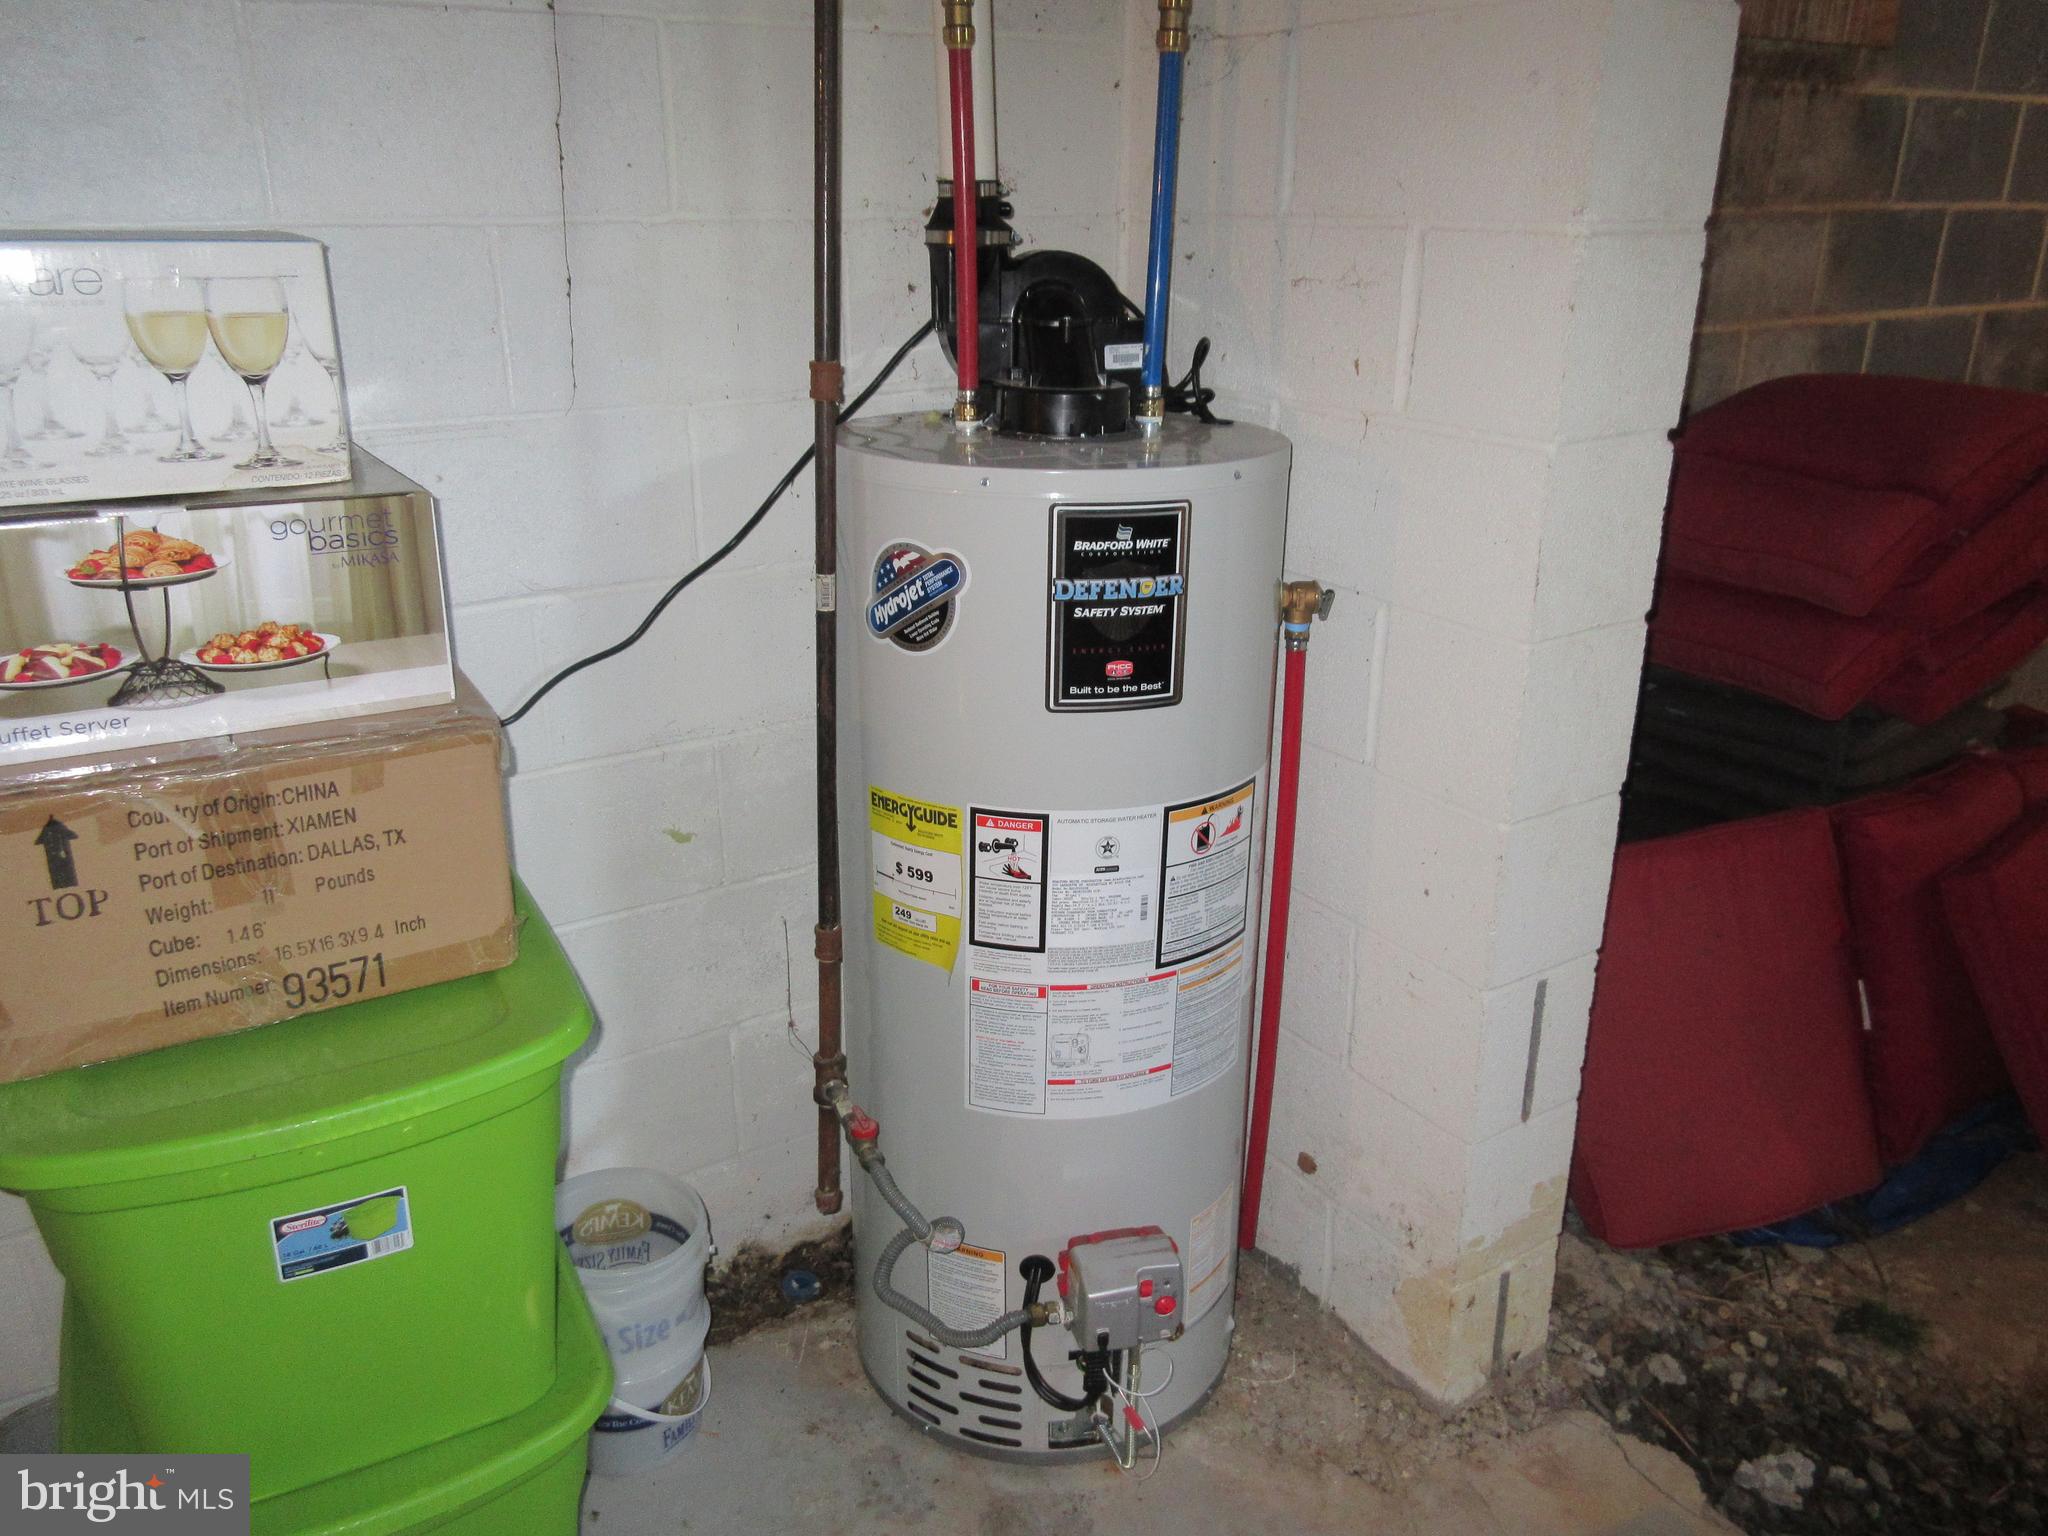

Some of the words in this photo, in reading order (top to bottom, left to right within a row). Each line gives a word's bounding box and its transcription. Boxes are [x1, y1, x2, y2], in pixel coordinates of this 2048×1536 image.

[270, 508, 393, 541] gourmet
[308, 529, 399, 552] basics
[1074, 540, 1133, 551] BRADFORD
[1136, 538, 1169, 549] WHITE
[341, 551, 399, 568] MIKASA
[1081, 549, 1162, 557] CORPORATION
[1054, 575, 1184, 601] DEFENDER
[873, 577, 925, 625] Hydrojet
[1074, 607, 1118, 618] SAFETY
[1120, 604, 1164, 616] SYSTEM
[1069, 686, 1092, 694] Built
[1094, 686, 1105, 694] to
[1107, 685, 1120, 693] be
[1122, 684, 1138, 692] the
[1141, 682, 1163, 691] Best
[59, 715, 131, 737] Server
[202, 798, 220, 817] of
[871, 791, 958, 830] ENERGYGUIDE
[134, 840, 174, 862] Port
[198, 821, 285, 850] Shipment:
[286, 807, 357, 835] XIAMEN
[997, 820, 1034, 830] DANGER
[138, 872, 178, 893] Port
[180, 866, 198, 886] of
[201, 849, 304, 881] Destination:
[307, 833, 381, 862] DALLAS,
[383, 828, 407, 846] TX
[895, 861, 904, 875] $
[907, 865, 934, 883] 599
[28, 888, 109, 927] TOP
[145, 899, 214, 925] Weight:
[314, 868, 376, 893] Pounds
[894, 906, 912, 920] 249
[149, 934, 202, 958] Cube:
[155, 950, 263, 988] Dimensions:
[394, 915, 427, 936] Inch
[163, 997, 202, 1018] Item
[282, 951, 386, 1010] 93571
[618, 1318, 671, 1355] Size
